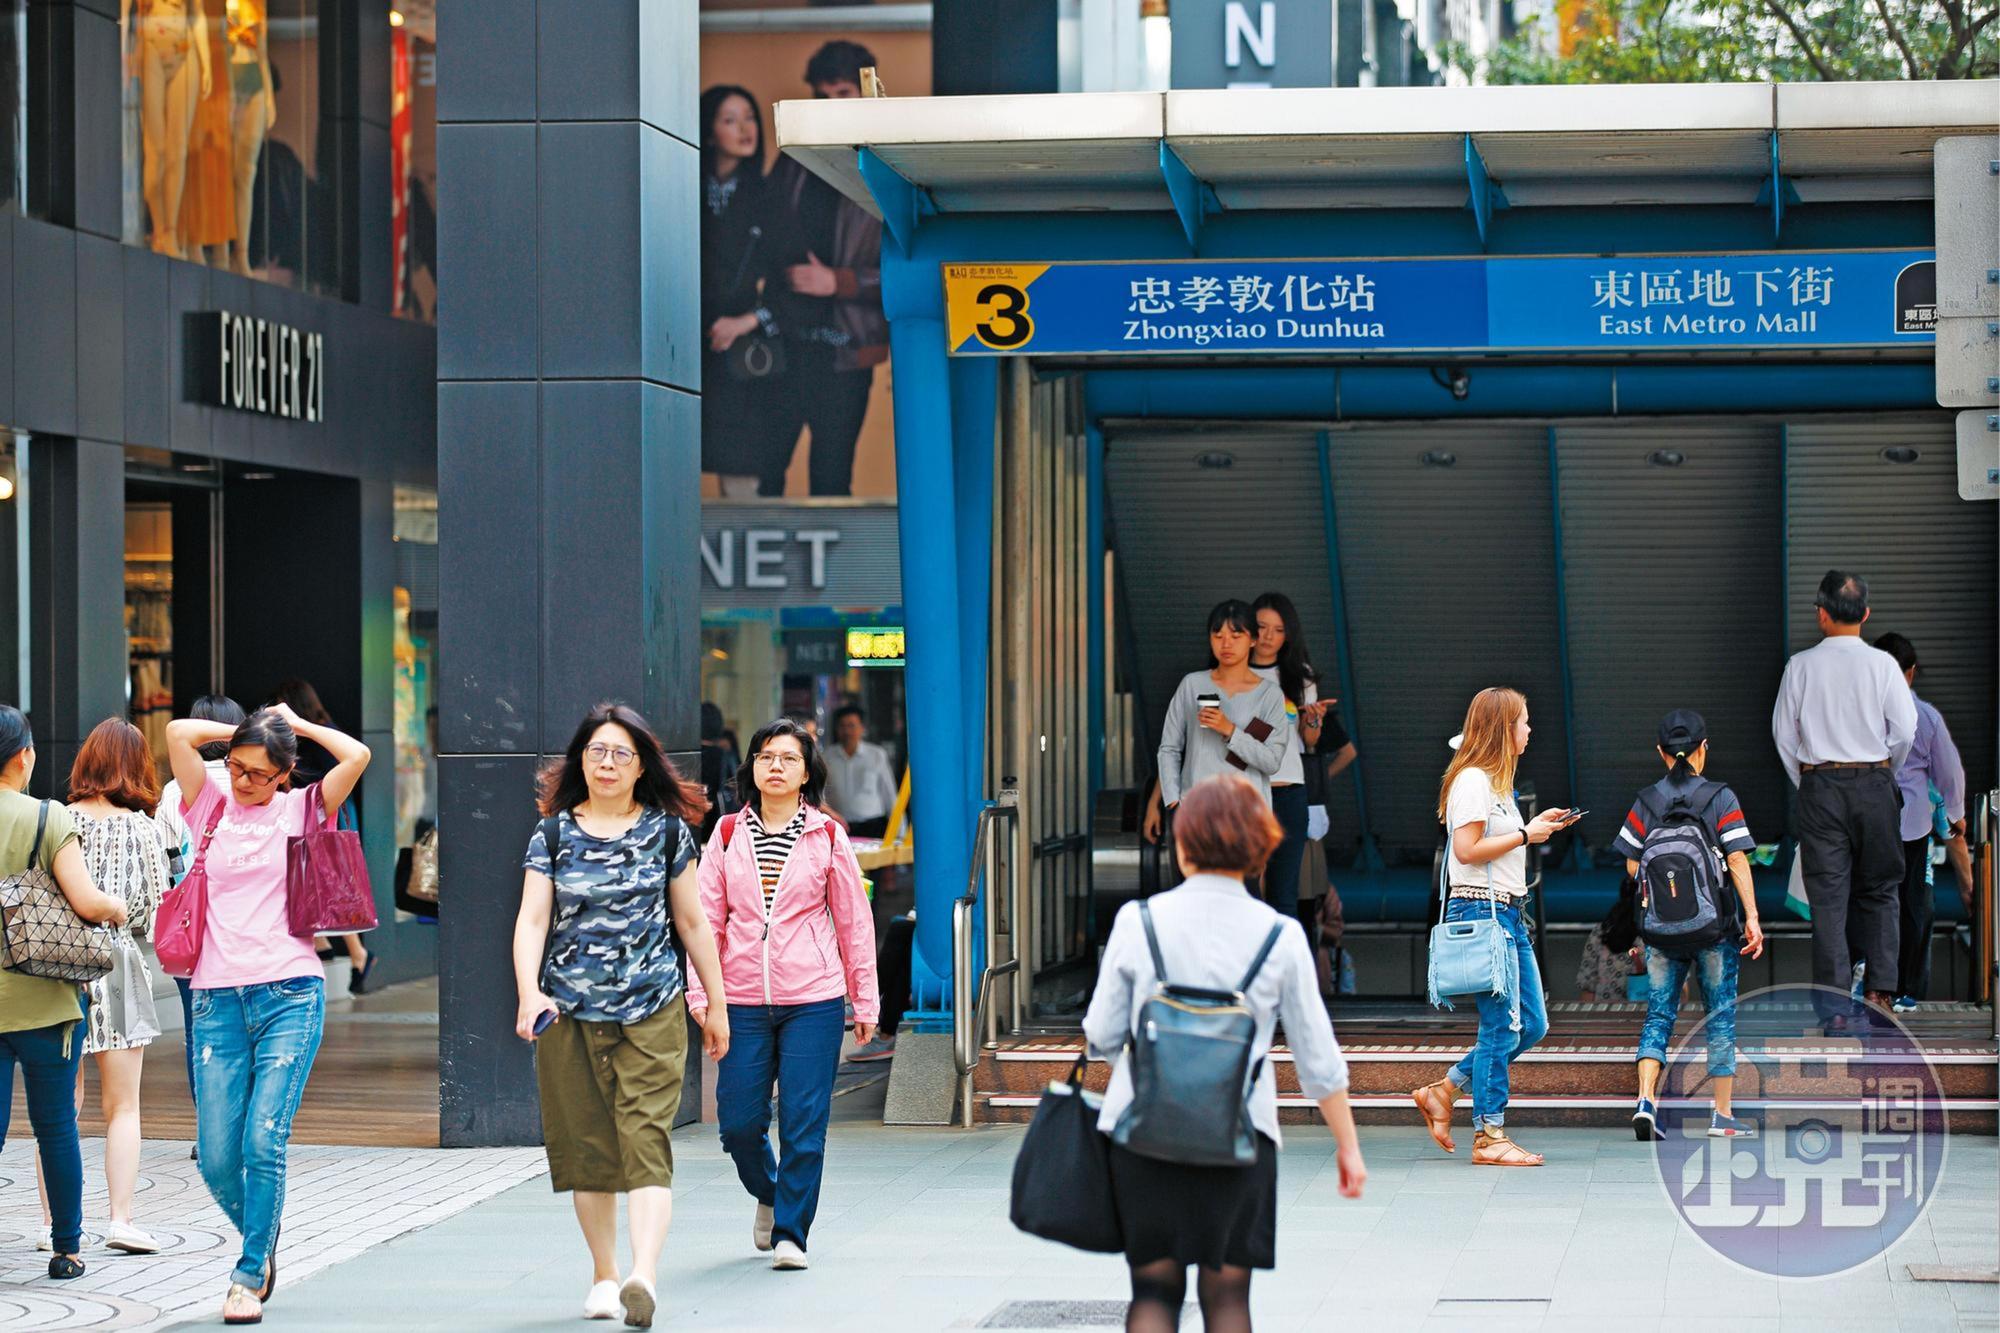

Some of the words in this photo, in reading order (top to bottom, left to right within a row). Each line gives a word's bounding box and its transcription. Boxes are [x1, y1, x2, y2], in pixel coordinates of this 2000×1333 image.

[1225, 1, 1276, 89] N
[1128, 274, 1376, 314] 忠孝敦化站
[1590, 266, 1834, 308] 東區地下街
[976, 284, 1030, 346] 3
[1123, 318, 1266, 345] Zhongxiao
[1276, 316, 1385, 338] Dunhua
[1600, 314, 1653, 335] East
[1663, 313, 1746, 334] Metro
[1756, 310, 1816, 333] Mall
[1904, 322, 1923, 330] East
[221, 310, 301, 419] FOREVER
[307, 331, 323, 422] 21
[701, 530, 840, 587] NET
